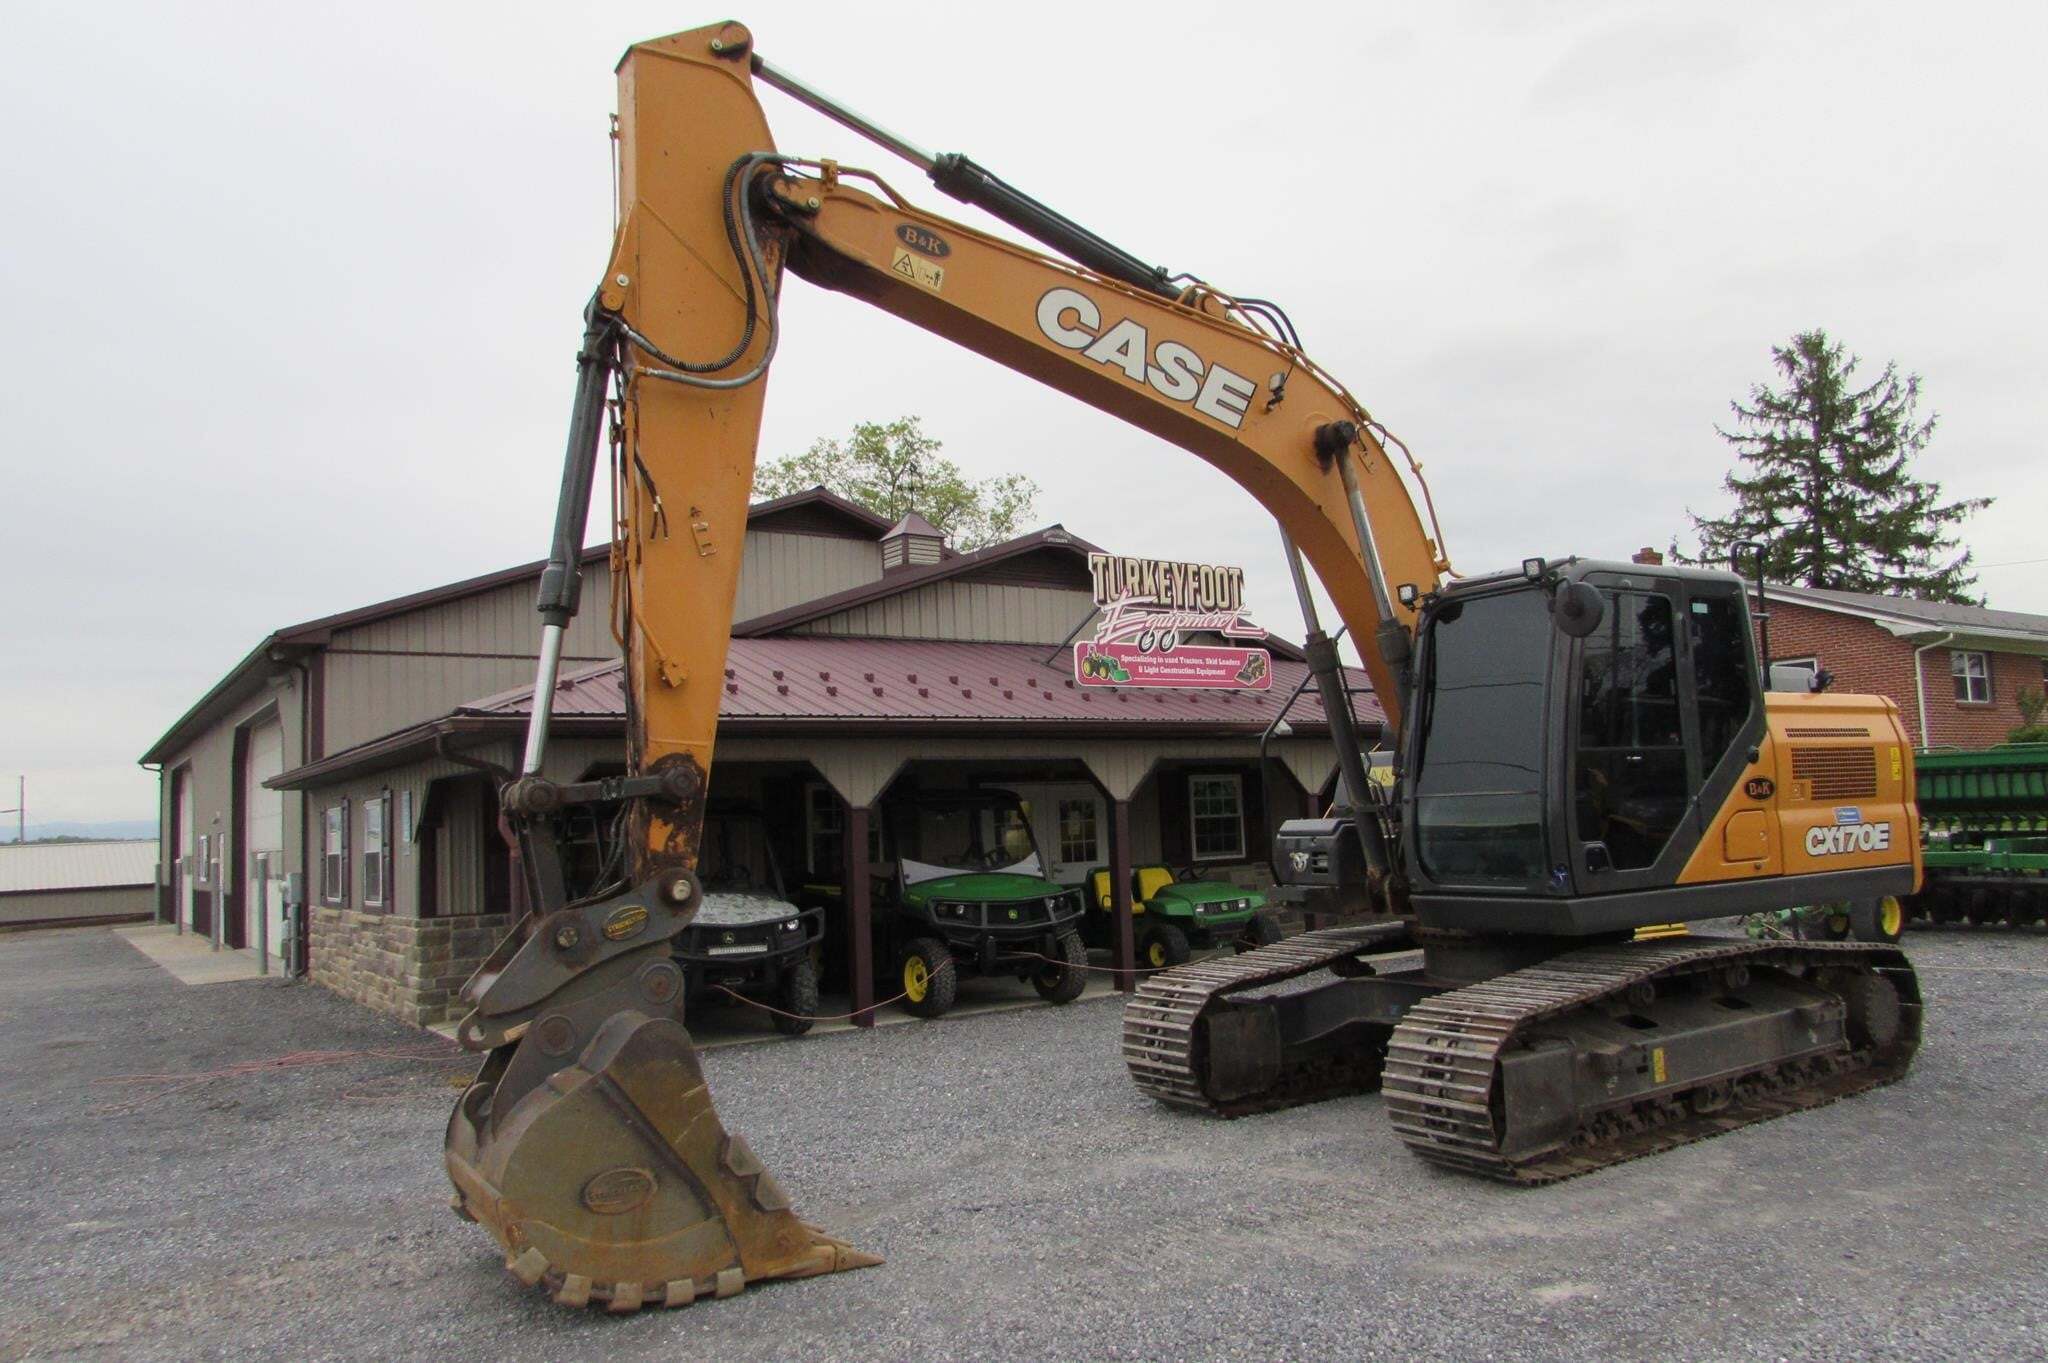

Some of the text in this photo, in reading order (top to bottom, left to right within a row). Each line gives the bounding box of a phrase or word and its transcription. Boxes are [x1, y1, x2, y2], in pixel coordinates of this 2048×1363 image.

[905, 227, 941, 254] B&K
[1036, 286, 1257, 430] CASE
[1091, 554, 1245, 610] TURKEYFOOT
[1094, 590, 1268, 645] Equipment
[1120, 654, 1157, 665] Specializing
[1219, 658, 1241, 666] Loaders
[1144, 665, 1159, 674] Light
[1160, 666, 1196, 674] Construction
[1196, 667, 1226, 676] Equipment
[1749, 782, 1770, 795] B&K
[1804, 822, 1890, 856] CX170E
